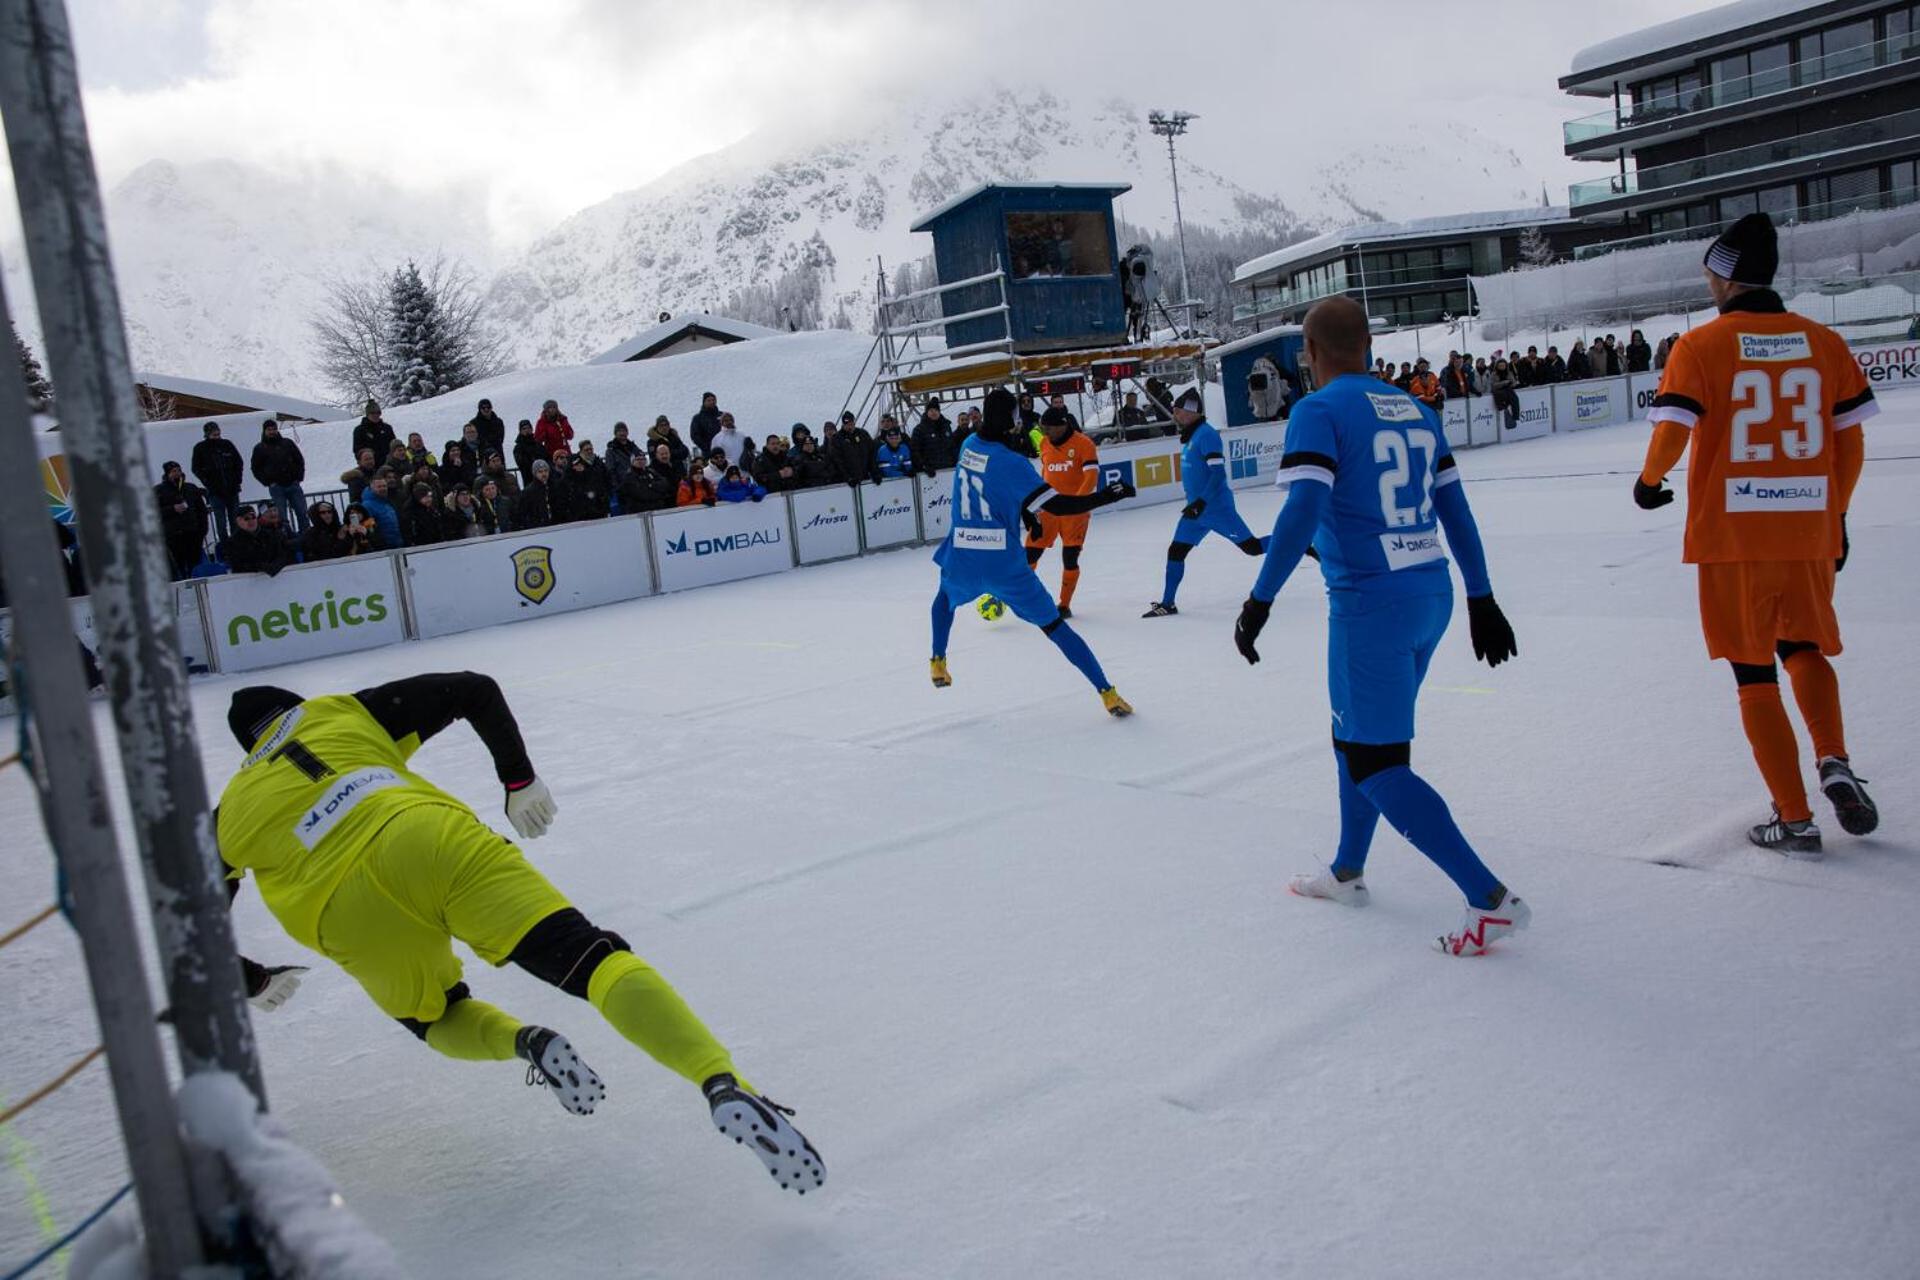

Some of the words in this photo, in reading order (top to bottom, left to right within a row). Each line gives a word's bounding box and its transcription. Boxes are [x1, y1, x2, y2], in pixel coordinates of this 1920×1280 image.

[1742, 335, 1804, 348] Champions
[1744, 347, 1769, 358] Club
[1857, 346, 1920, 366] omm
[1637, 390, 1657, 409] OB
[1520, 401, 1549, 422] smzh
[1731, 367, 1823, 462] 23
[1231, 439, 1263, 458] Blue
[1373, 428, 1437, 528] 27
[959, 468, 992, 520] 11
[1756, 487, 1821, 499] DMBAU
[802, 513, 848, 530] Arosa
[868, 504, 911, 521] Arosa
[694, 527, 781, 556] DMBAU
[1406, 538, 1440, 552] DMBA
[228, 590, 387, 645] netrics
[267, 739, 337, 783] 1
[324, 772, 396, 814] DMBAU
